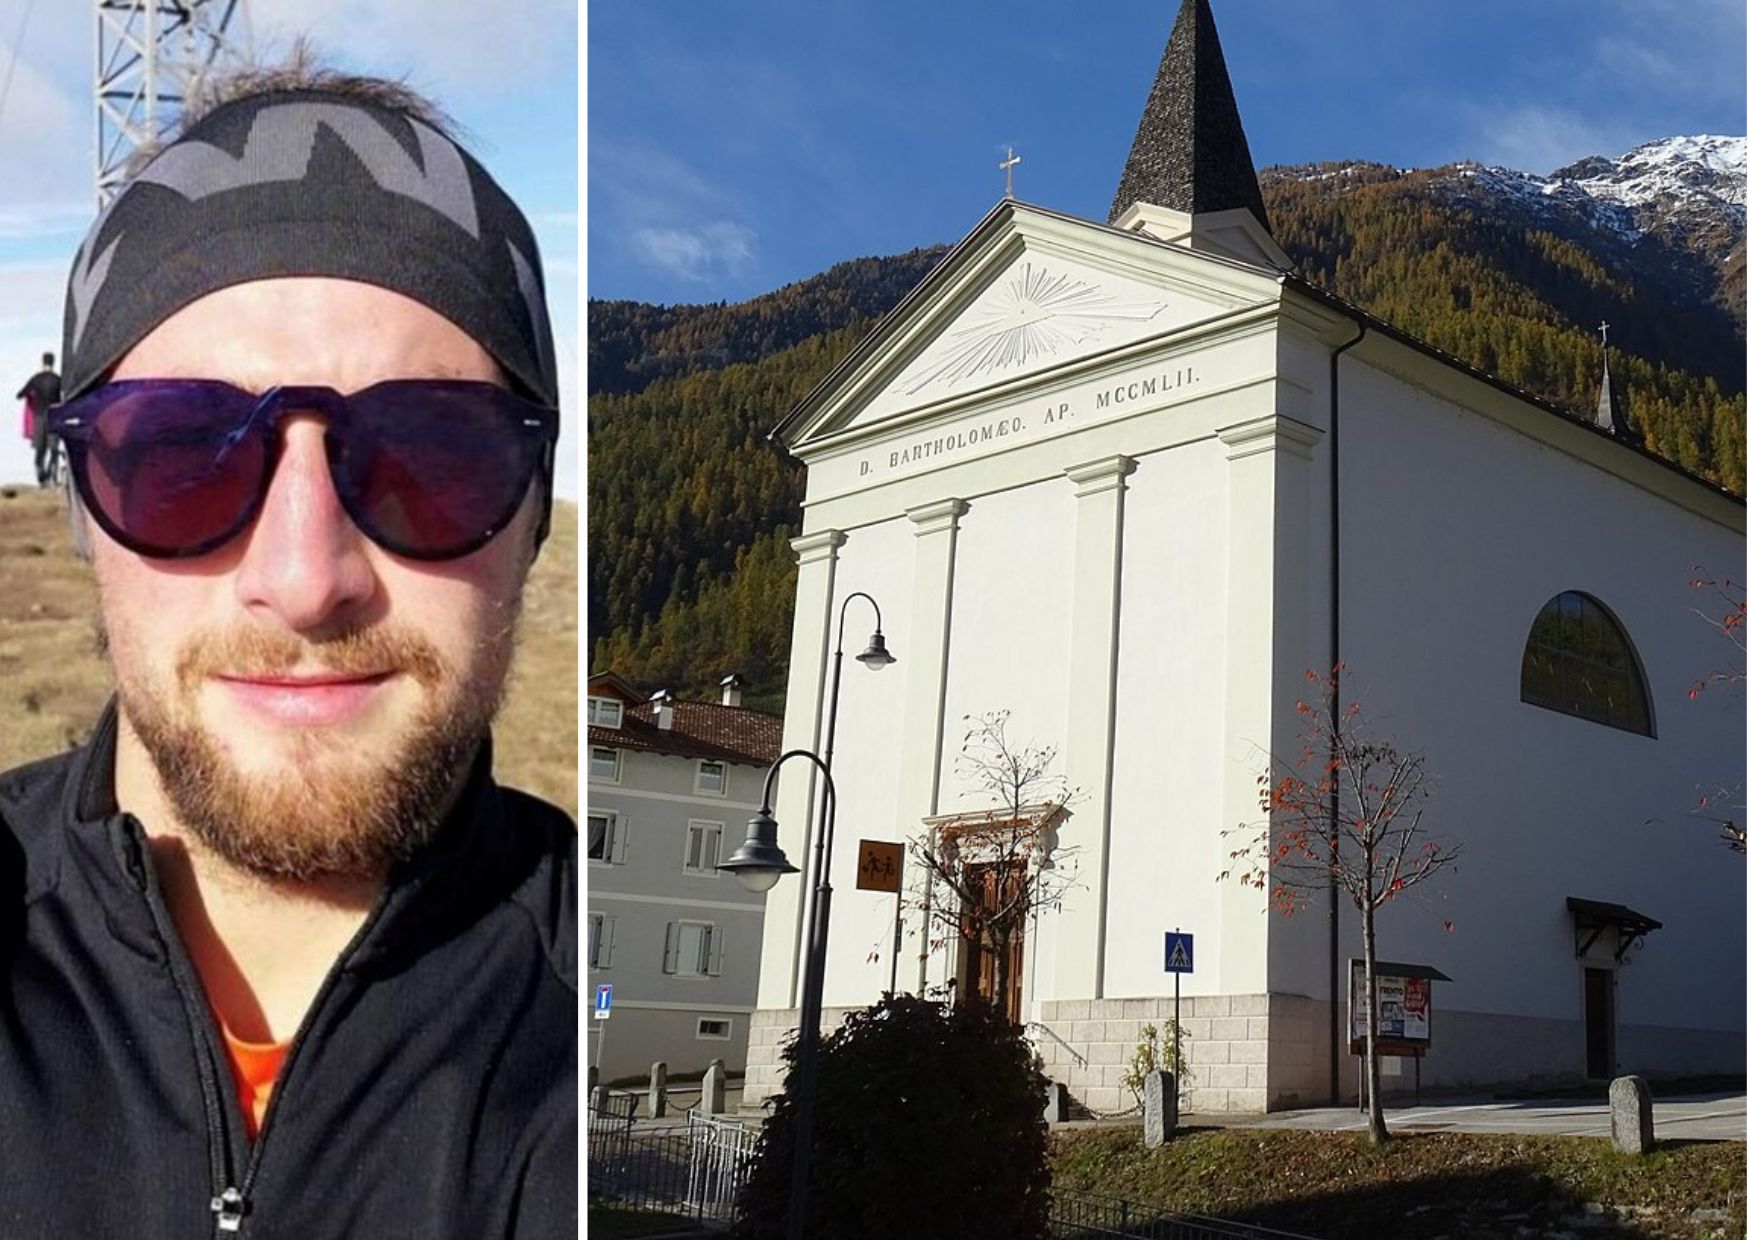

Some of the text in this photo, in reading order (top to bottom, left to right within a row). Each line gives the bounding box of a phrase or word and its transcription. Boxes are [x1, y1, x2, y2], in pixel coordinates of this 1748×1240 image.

[860, 461, 873, 476] D.
[1043, 403, 1075, 424] AP.
[1096, 367, 1200, 409] MCCMLII.
